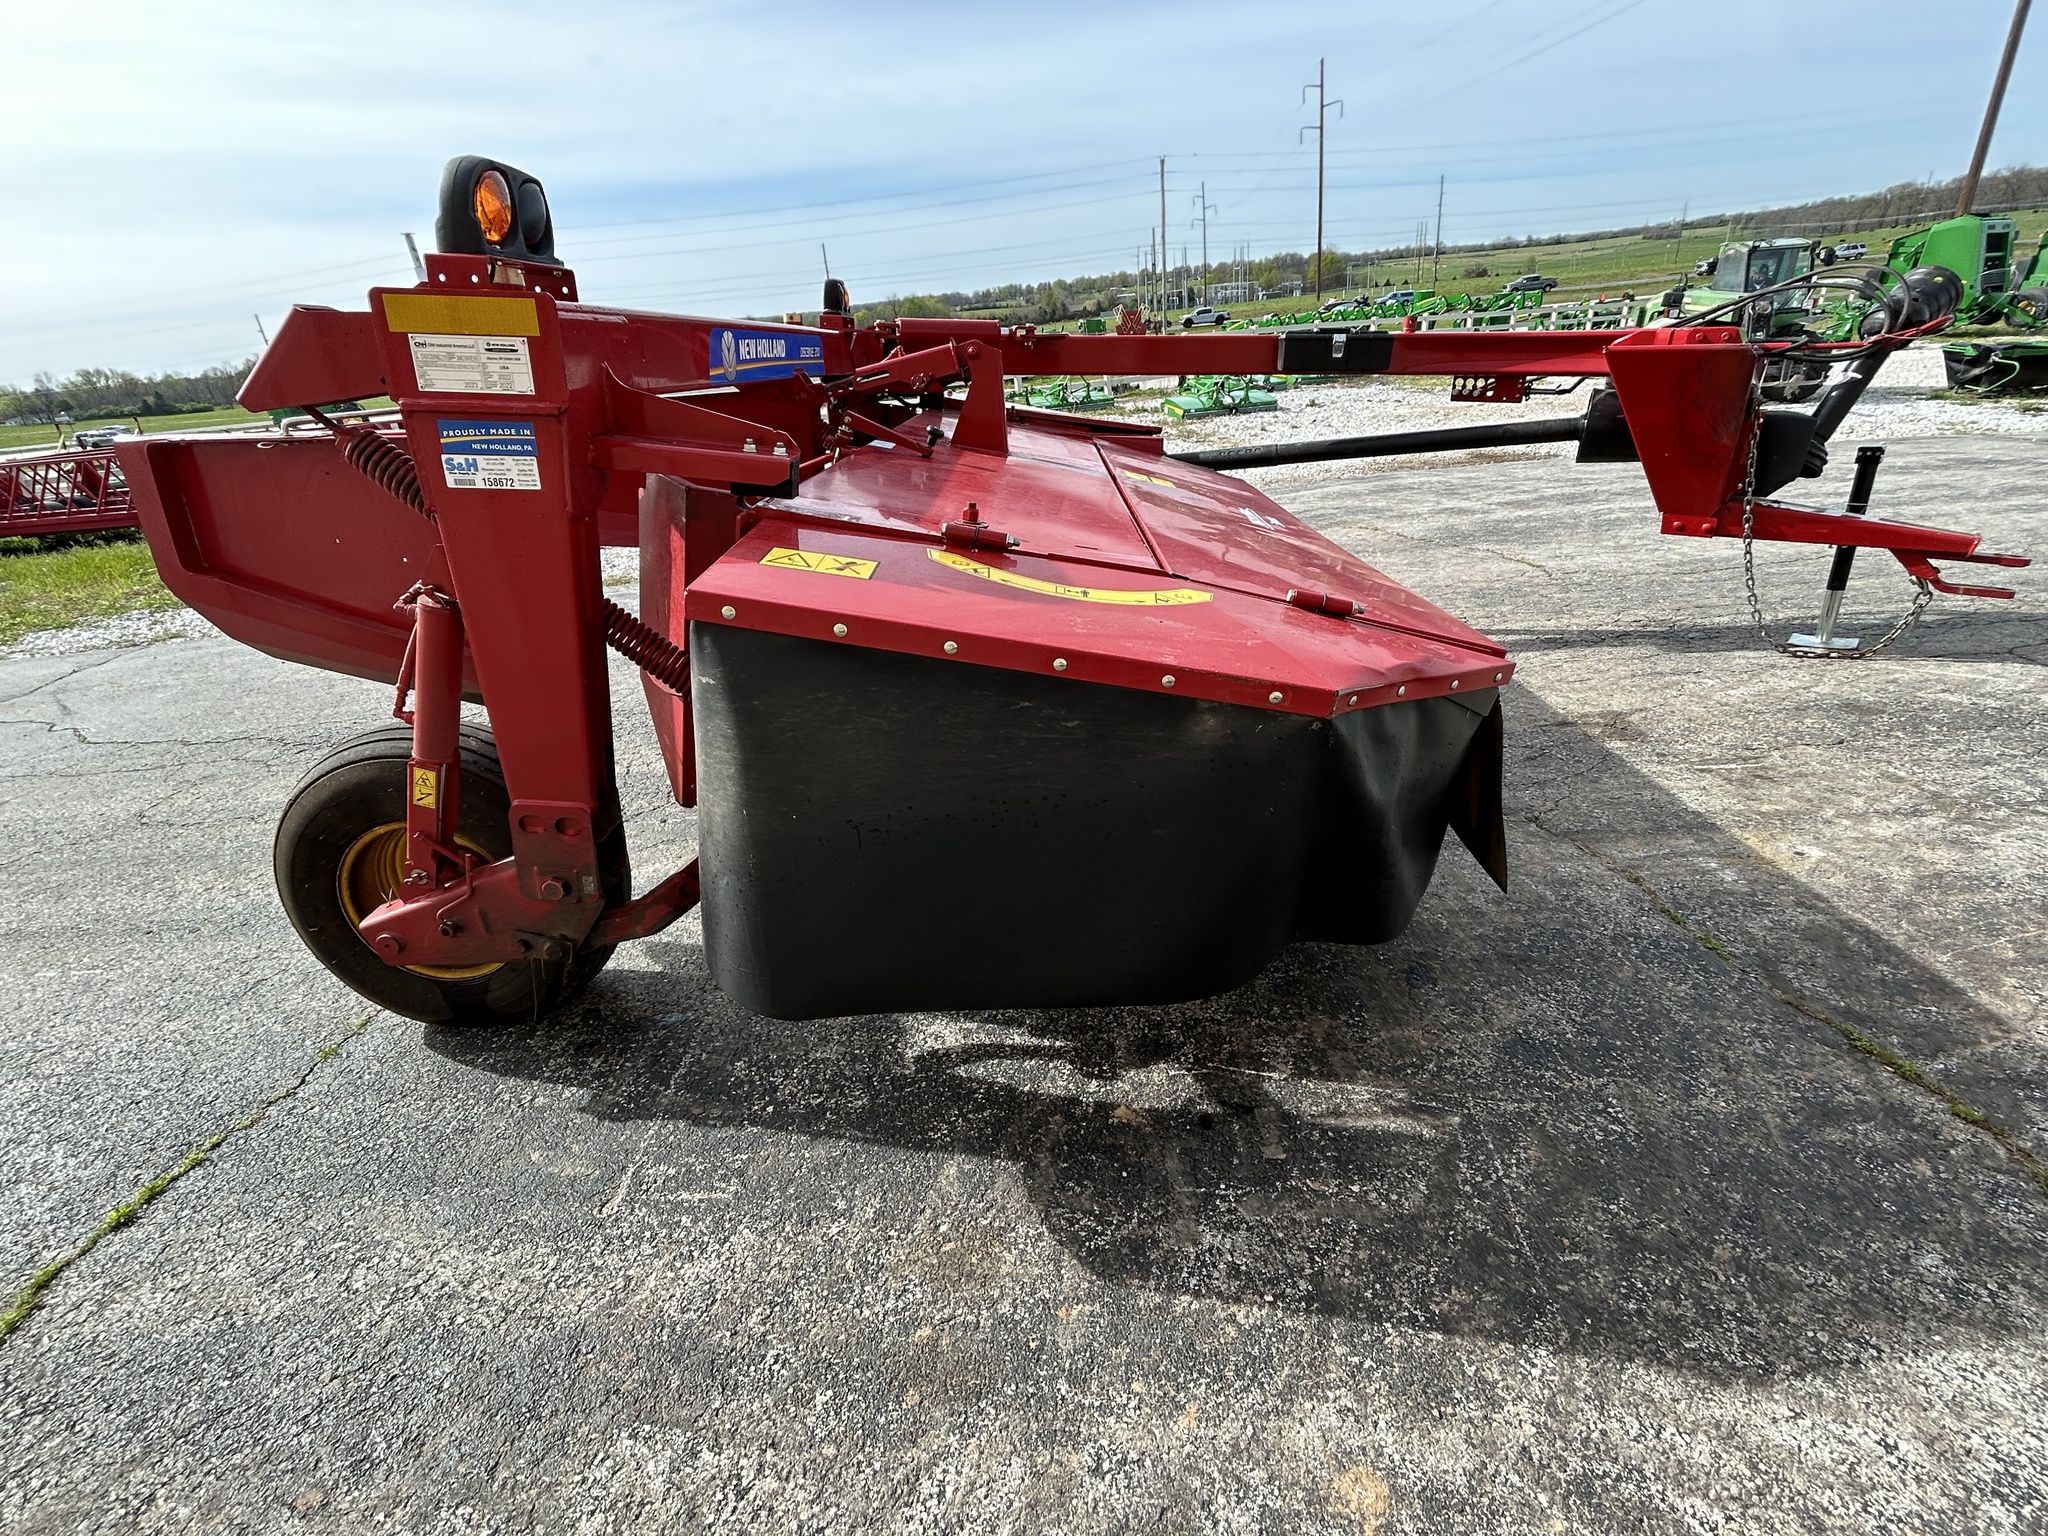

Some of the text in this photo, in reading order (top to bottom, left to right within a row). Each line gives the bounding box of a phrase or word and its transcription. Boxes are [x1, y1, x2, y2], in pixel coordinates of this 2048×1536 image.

[739, 339, 786, 360] NEW HOLLAND
[443, 429, 486, 437] PROUDLY
[444, 457, 479, 472] S&H
[482, 477, 515, 488] 158672
